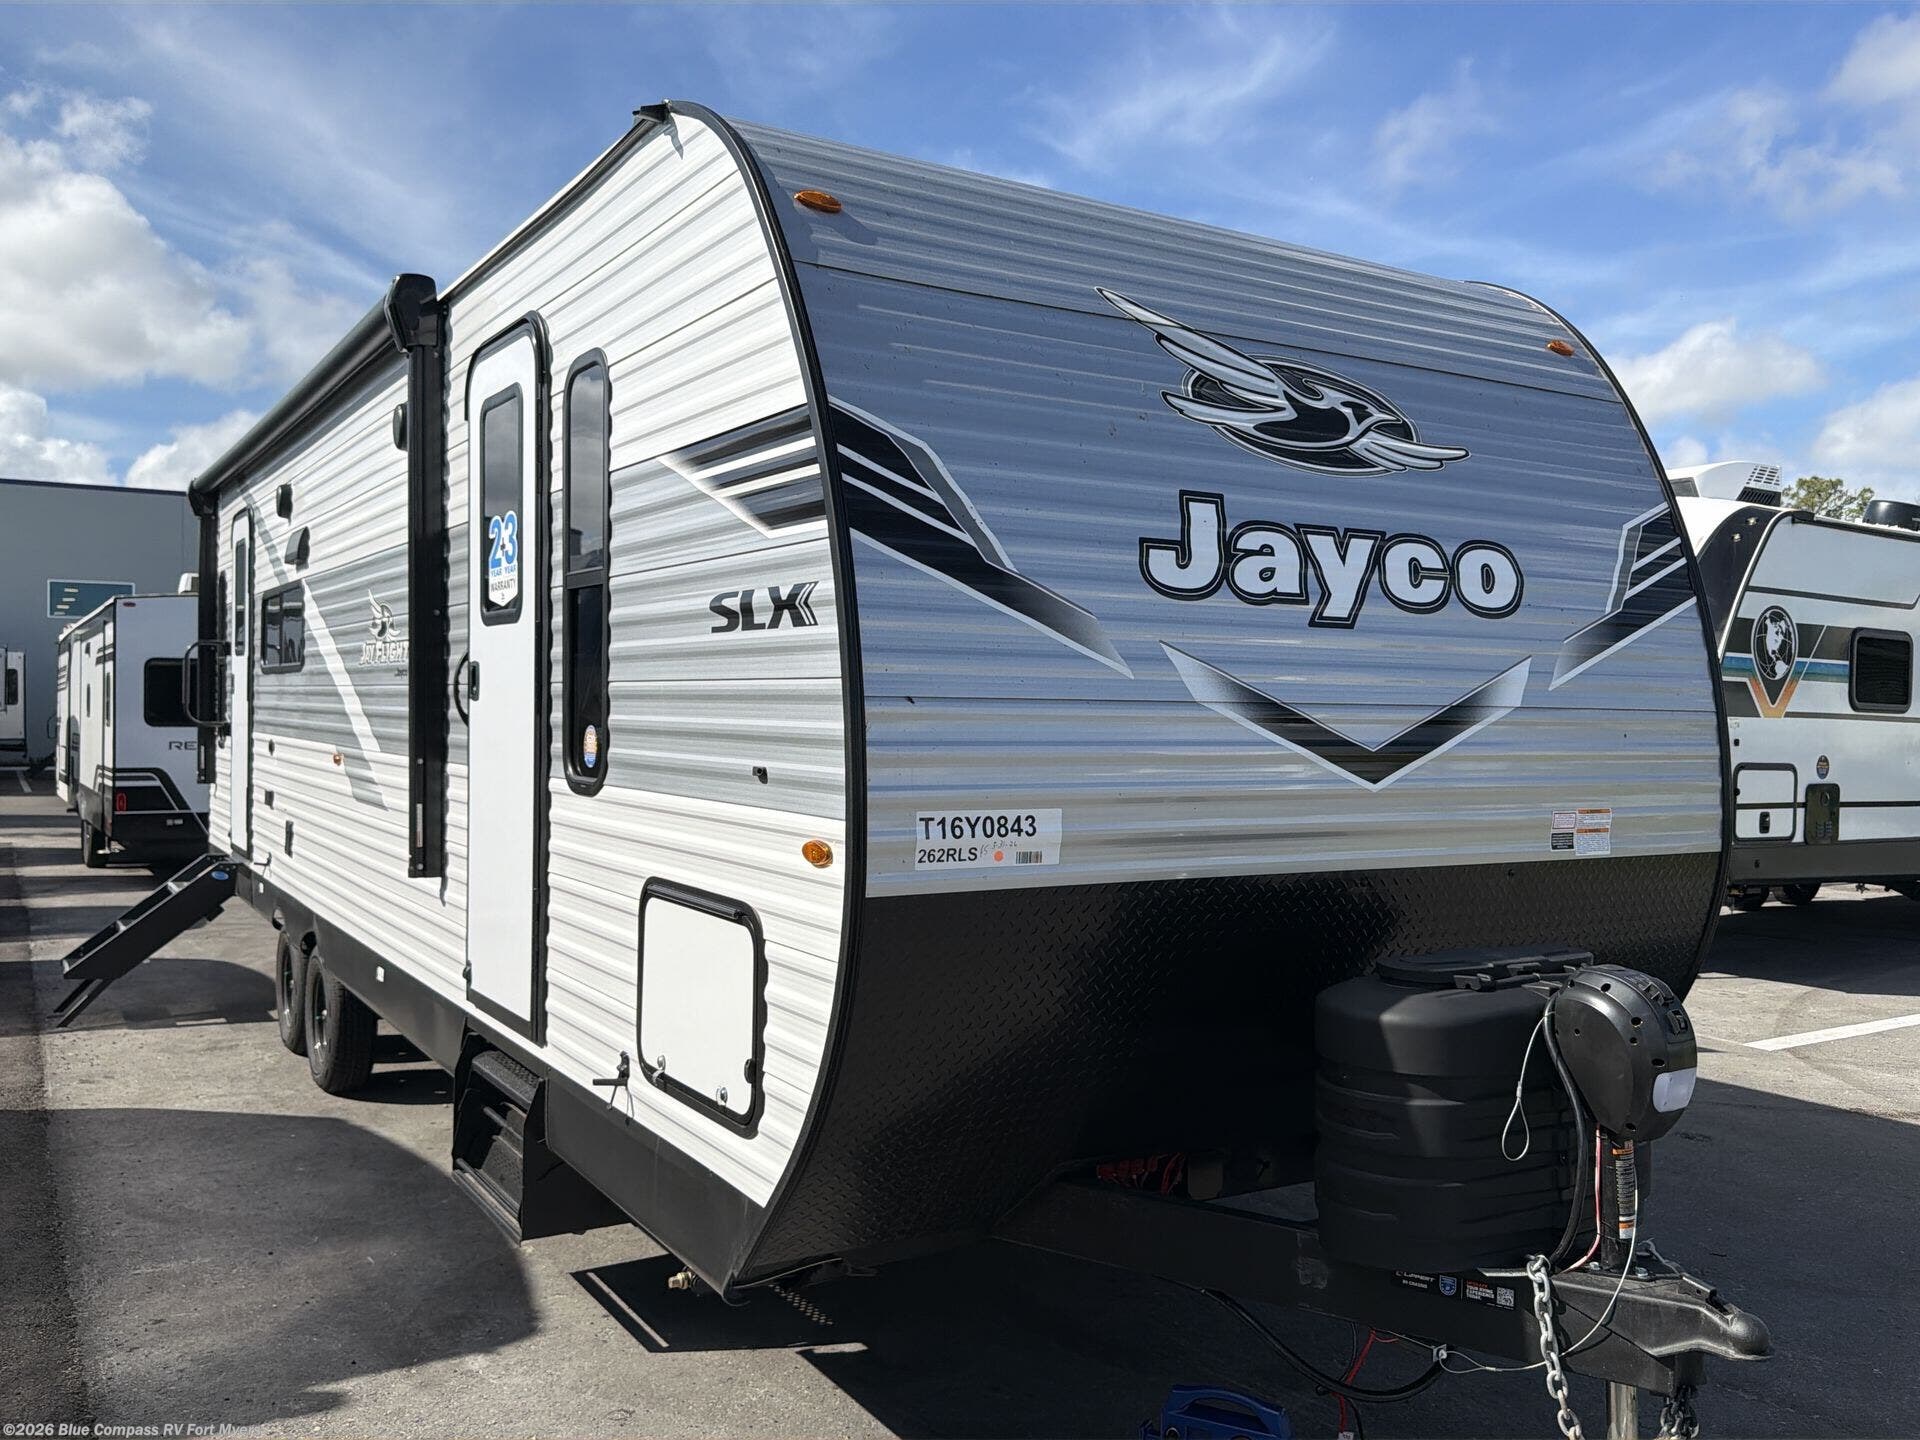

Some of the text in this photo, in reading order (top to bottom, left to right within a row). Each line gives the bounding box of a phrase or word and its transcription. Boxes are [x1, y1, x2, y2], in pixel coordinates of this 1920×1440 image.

[1138, 489, 1524, 629] Jayco
[490, 579, 516, 593] WARRANTY
[709, 581, 819, 633] SLX
[359, 641, 409, 667] JAY FLIGHT
[919, 815, 1037, 840] T16Y0843
[917, 847, 978, 864] 262RLS
